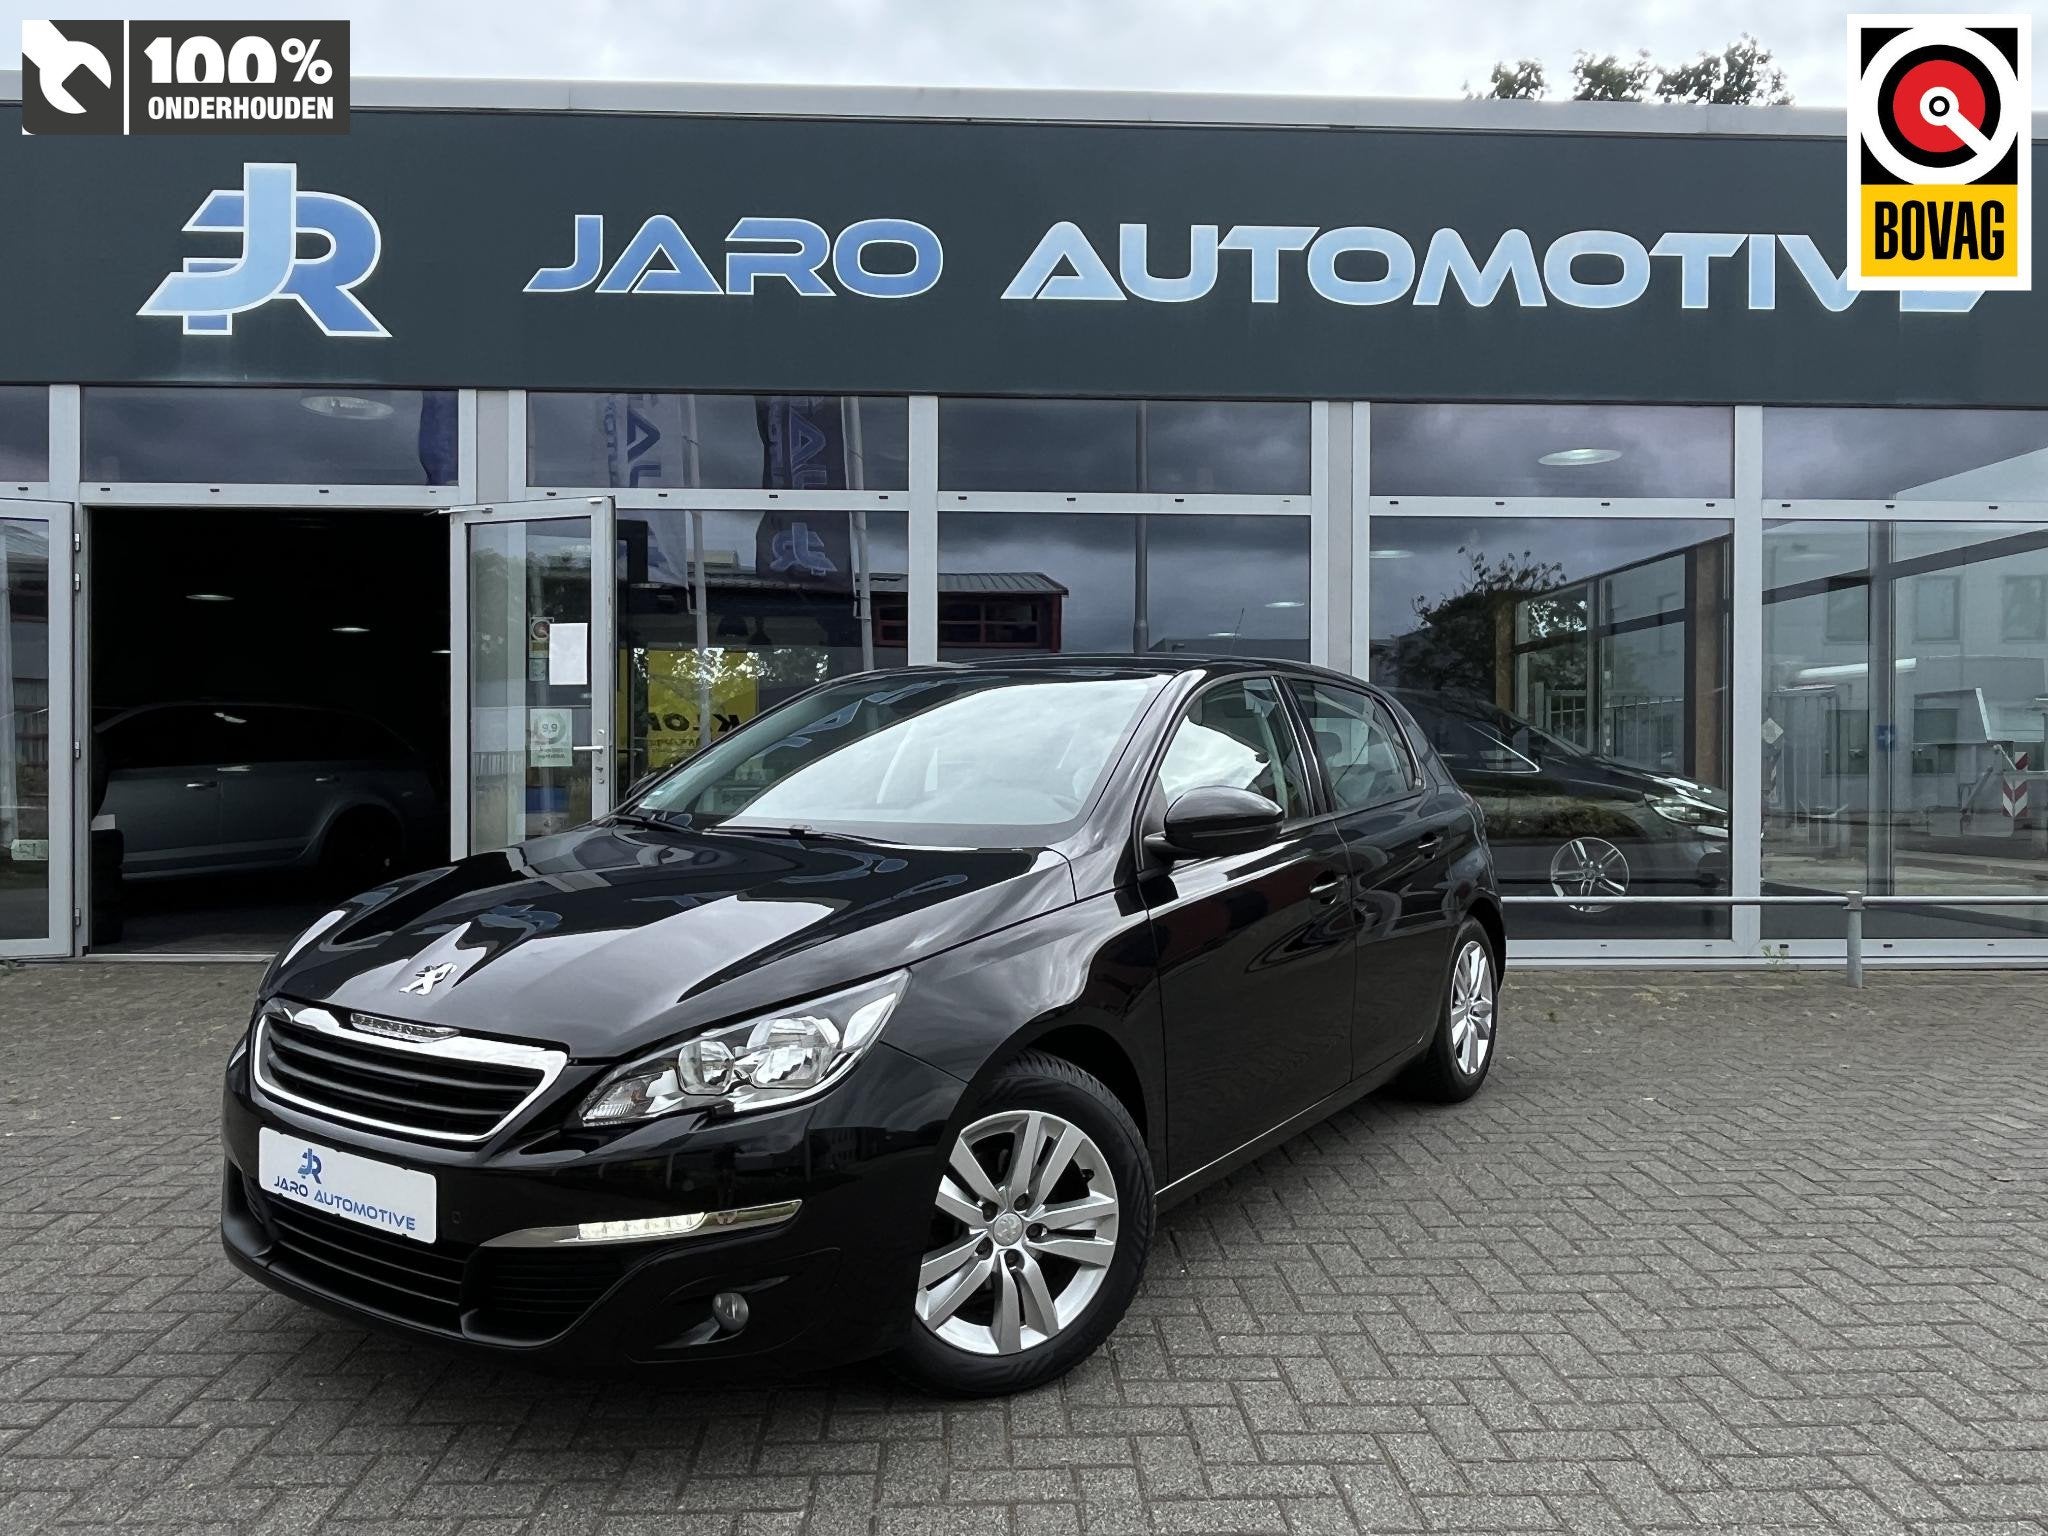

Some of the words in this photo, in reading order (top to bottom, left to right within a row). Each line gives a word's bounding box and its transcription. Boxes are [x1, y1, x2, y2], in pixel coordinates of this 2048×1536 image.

[523, 215, 943, 298] JARO
[1000, 221, 1985, 312] AUTOMOTIV
[274, 1176, 308, 1197] JARO
[314, 1189, 416, 1231] AUTOMOTIVE
